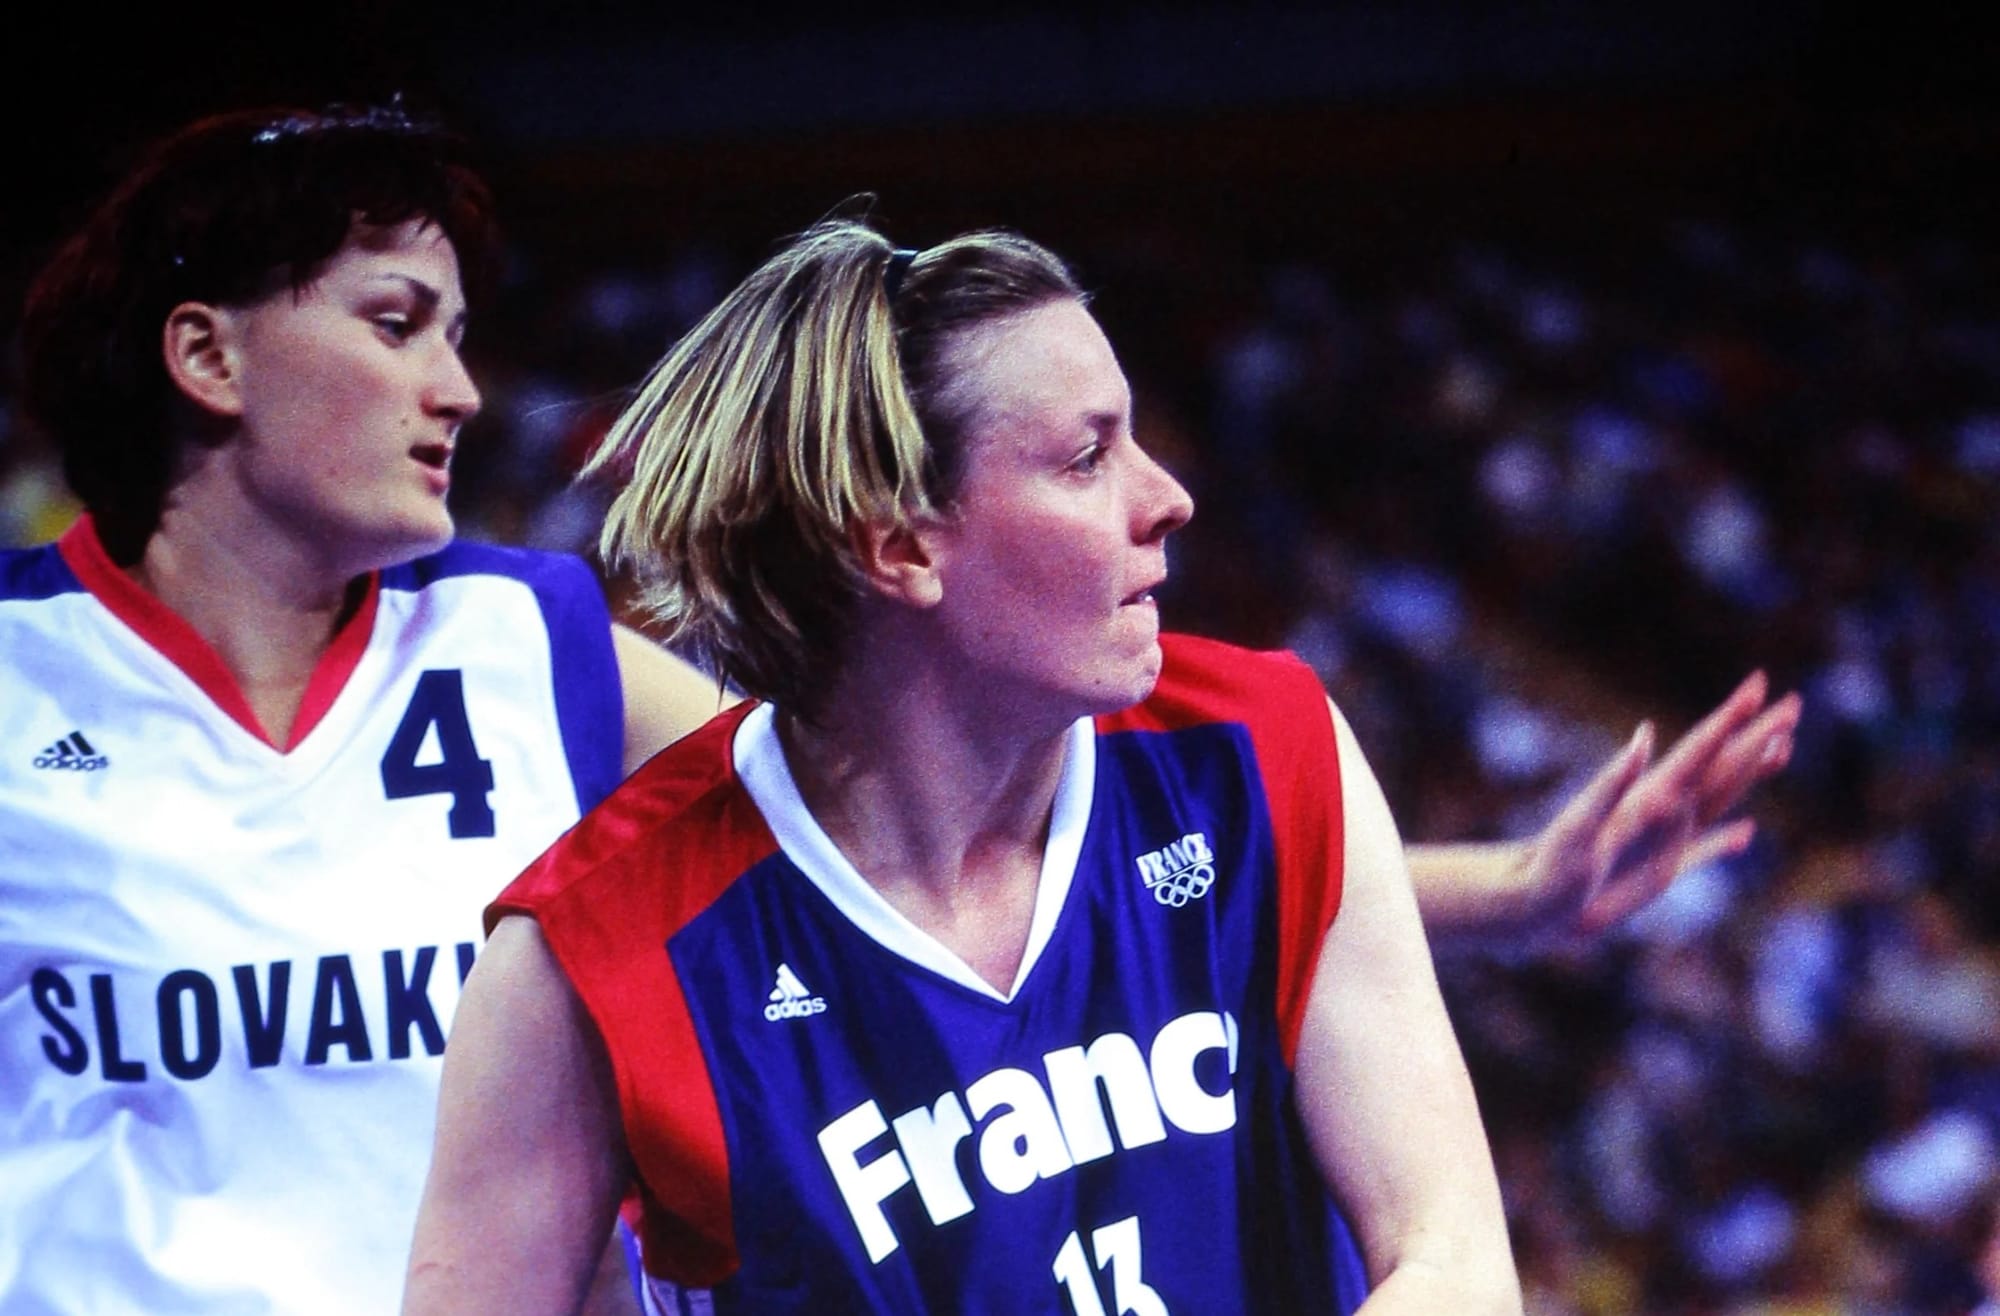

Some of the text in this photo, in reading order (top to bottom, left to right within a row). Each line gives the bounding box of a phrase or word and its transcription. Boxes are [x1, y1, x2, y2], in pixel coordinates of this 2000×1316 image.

[33, 756, 109, 771] adidas
[381, 668, 495, 838] 4
[1136, 832, 1213, 885] FRANCE
[817, 1011, 1238, 1265] Franc
[1052, 1215, 1170, 1316] 13
